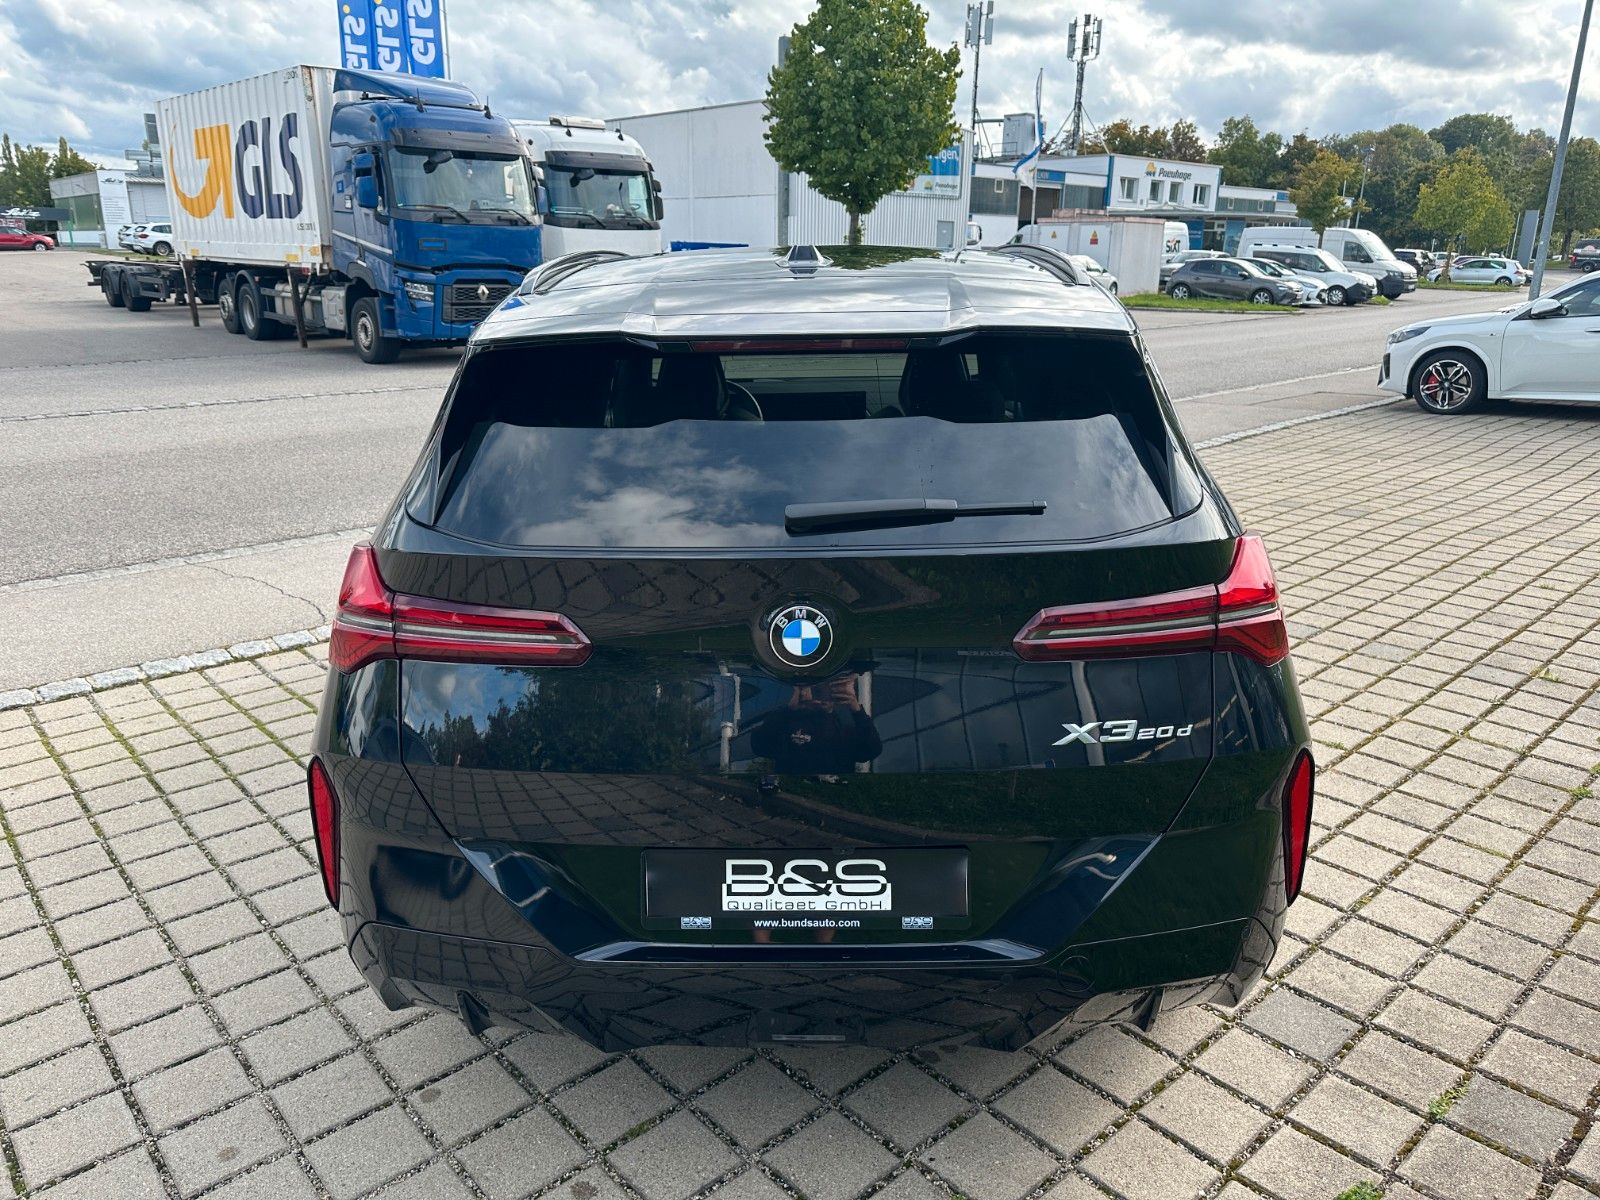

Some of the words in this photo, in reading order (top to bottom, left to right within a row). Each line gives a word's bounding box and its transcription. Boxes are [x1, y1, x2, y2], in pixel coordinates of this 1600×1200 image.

[235, 112, 304, 219] GLS
[776, 608, 827, 629] BMW
[1052, 719, 1138, 746] X3
[726, 859, 888, 896] B&S
[727, 899, 816, 911] Qualitaet
[754, 918, 861, 928] www.bundsauto.com
